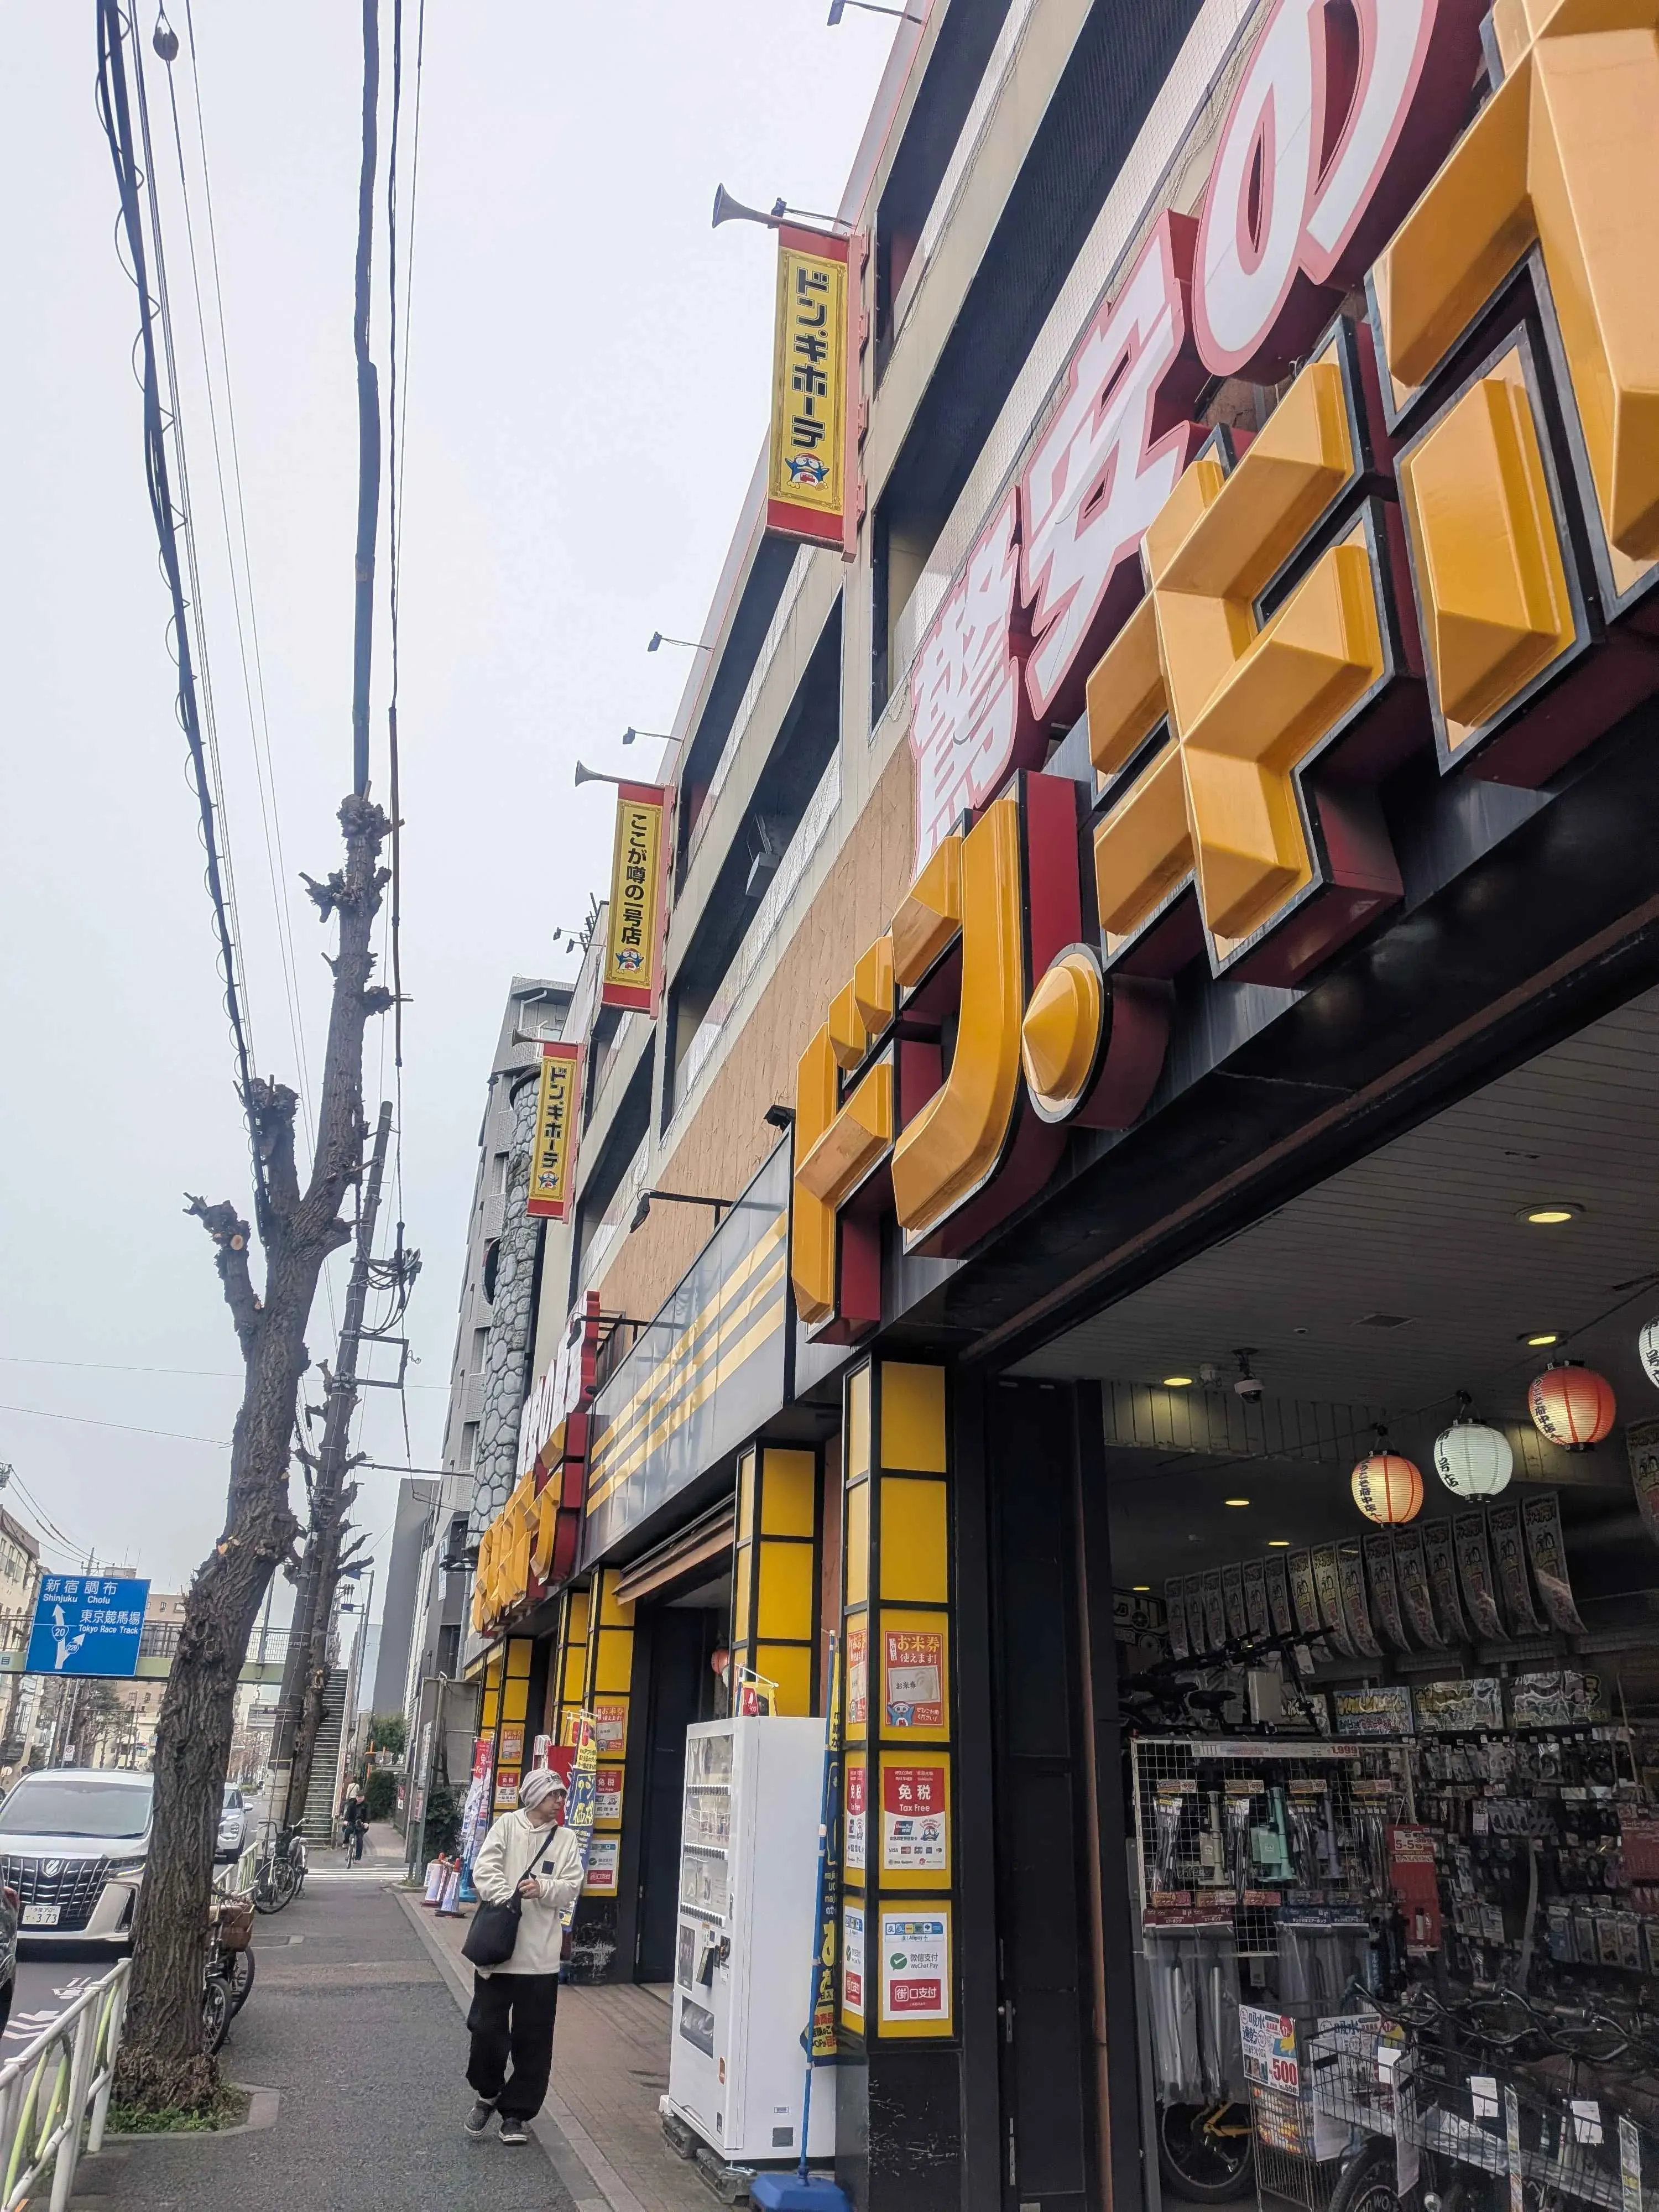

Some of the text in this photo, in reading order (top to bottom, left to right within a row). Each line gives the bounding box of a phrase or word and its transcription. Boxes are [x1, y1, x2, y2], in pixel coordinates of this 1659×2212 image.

[620, 813, 647, 946] ここが噂の一号店
[45, 1578, 118, 1595] 新宿 調布
[43, 1593, 111, 1604] Shinjuku Chofu
[79, 1609, 141, 1625] 東京競馬場
[55, 1628, 65, 1637] 20
[79, 1624, 98, 1634] Tokyo
[120, 1626, 138, 1634] Track
[898, 1635, 940, 1652] お米券
[896, 1681, 916, 1690] お米券
[898, 1783, 931, 1800] 免税
[899, 1803, 930, 1812] Tax Free
[910, 1953, 938, 1963] 微信支付
[1249, 2011, 1265, 2030] 吸水
[1272, 2058, 1297, 2085] 500
